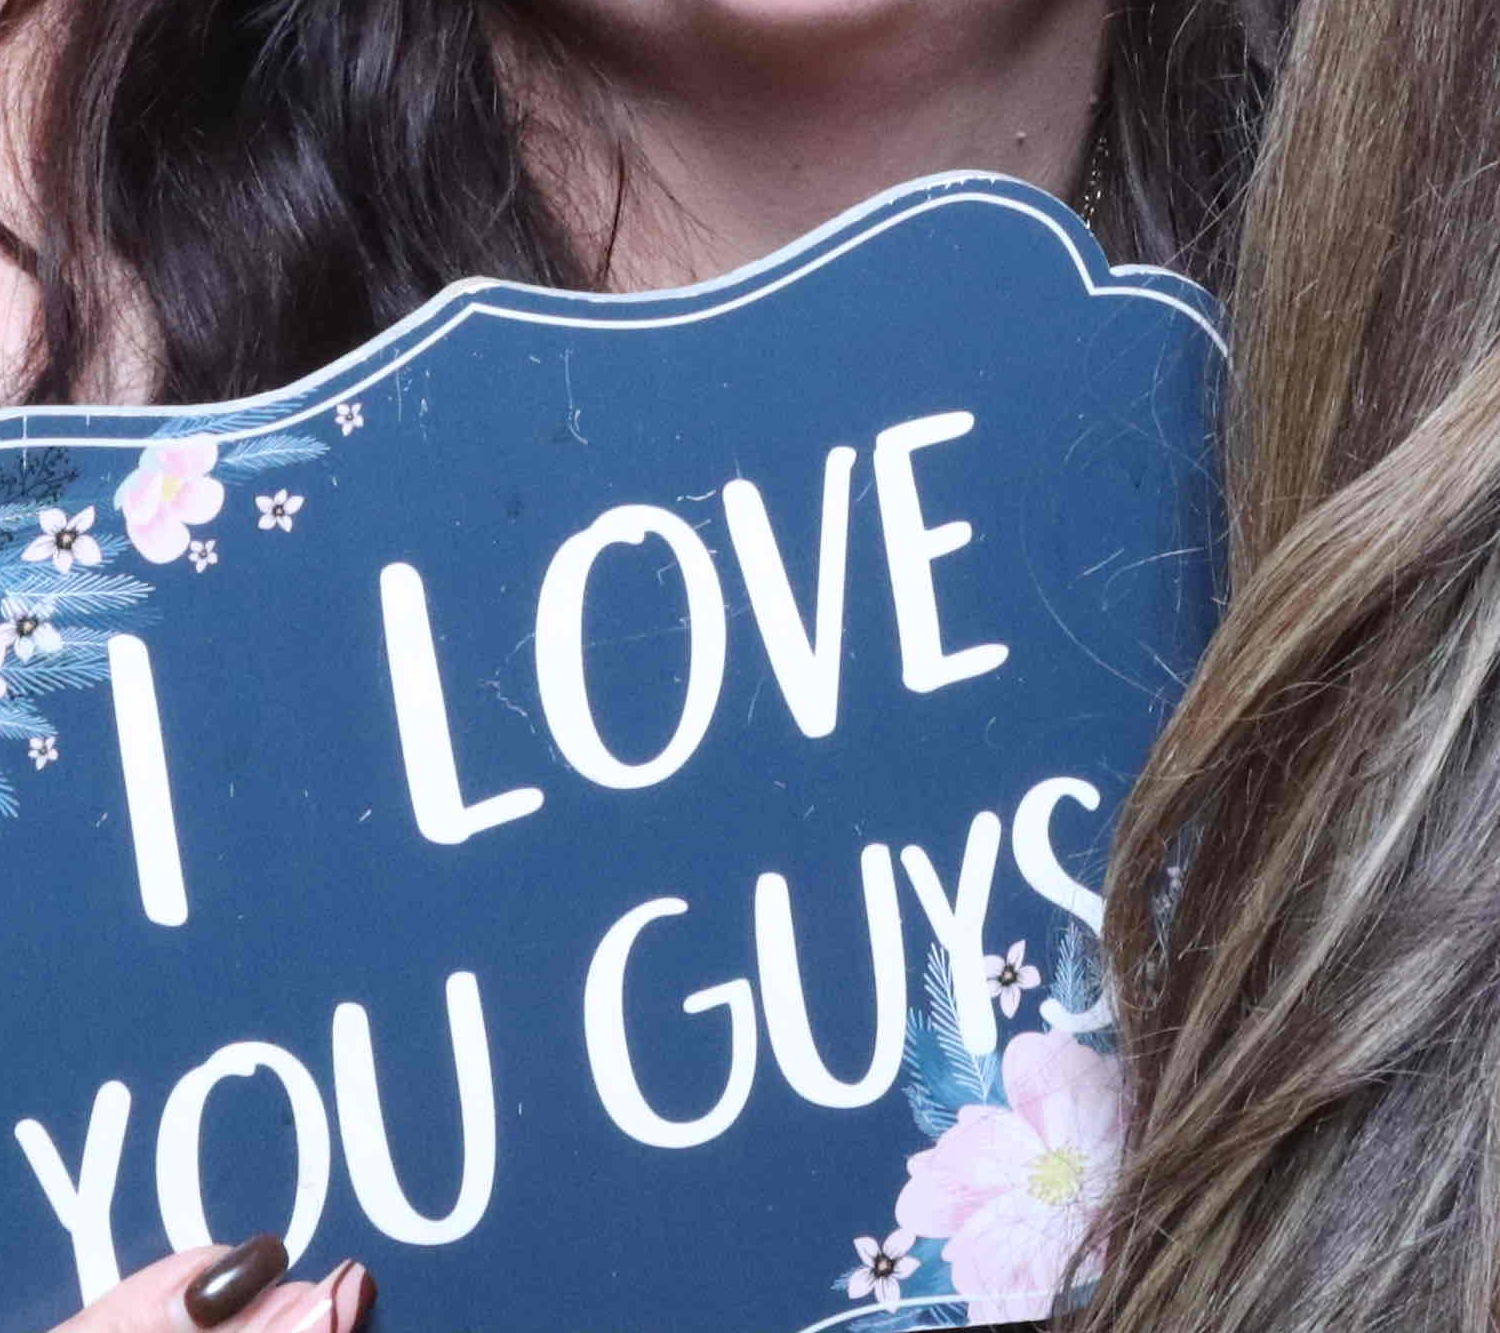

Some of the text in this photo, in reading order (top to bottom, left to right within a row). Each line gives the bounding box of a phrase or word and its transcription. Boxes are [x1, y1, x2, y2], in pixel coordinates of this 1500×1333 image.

[106, 409, 1009, 927] I LOVE
[12, 774, 1116, 1307] YOU GUYS
